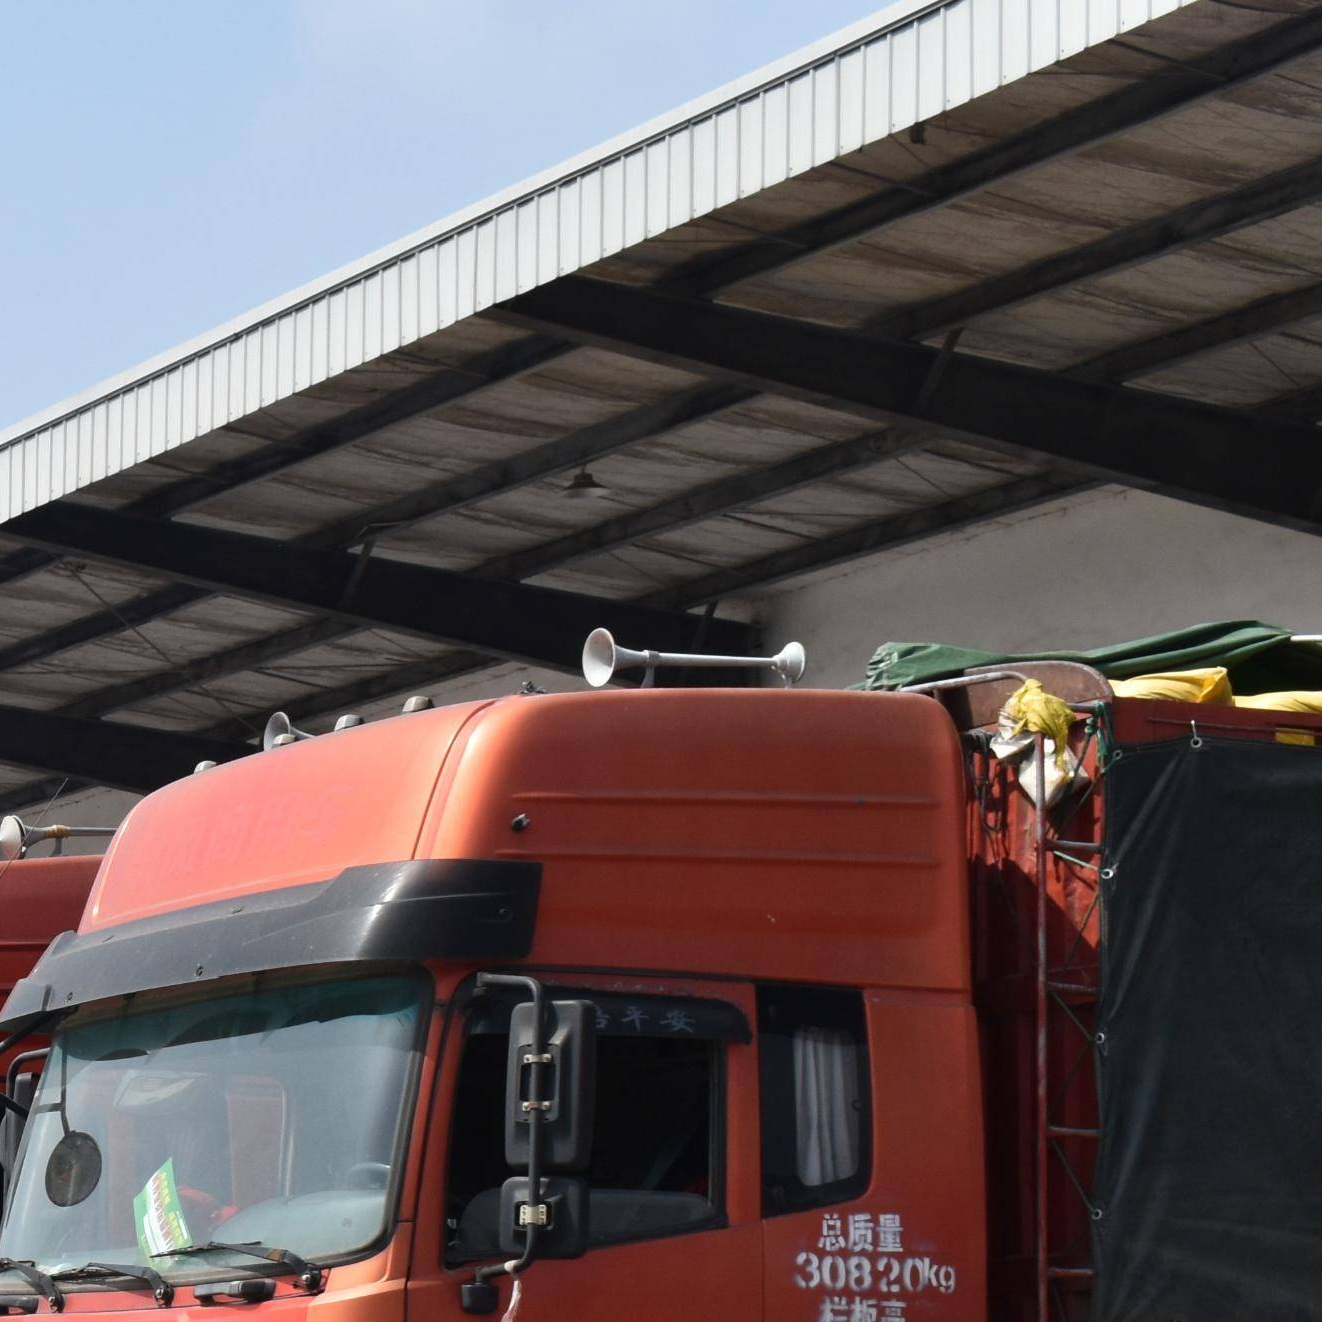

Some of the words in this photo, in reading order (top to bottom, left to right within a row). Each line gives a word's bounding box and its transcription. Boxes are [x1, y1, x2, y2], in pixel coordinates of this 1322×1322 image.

[817, 1213, 904, 1253] 总质量
[795, 1251, 956, 1294] 30820kg
